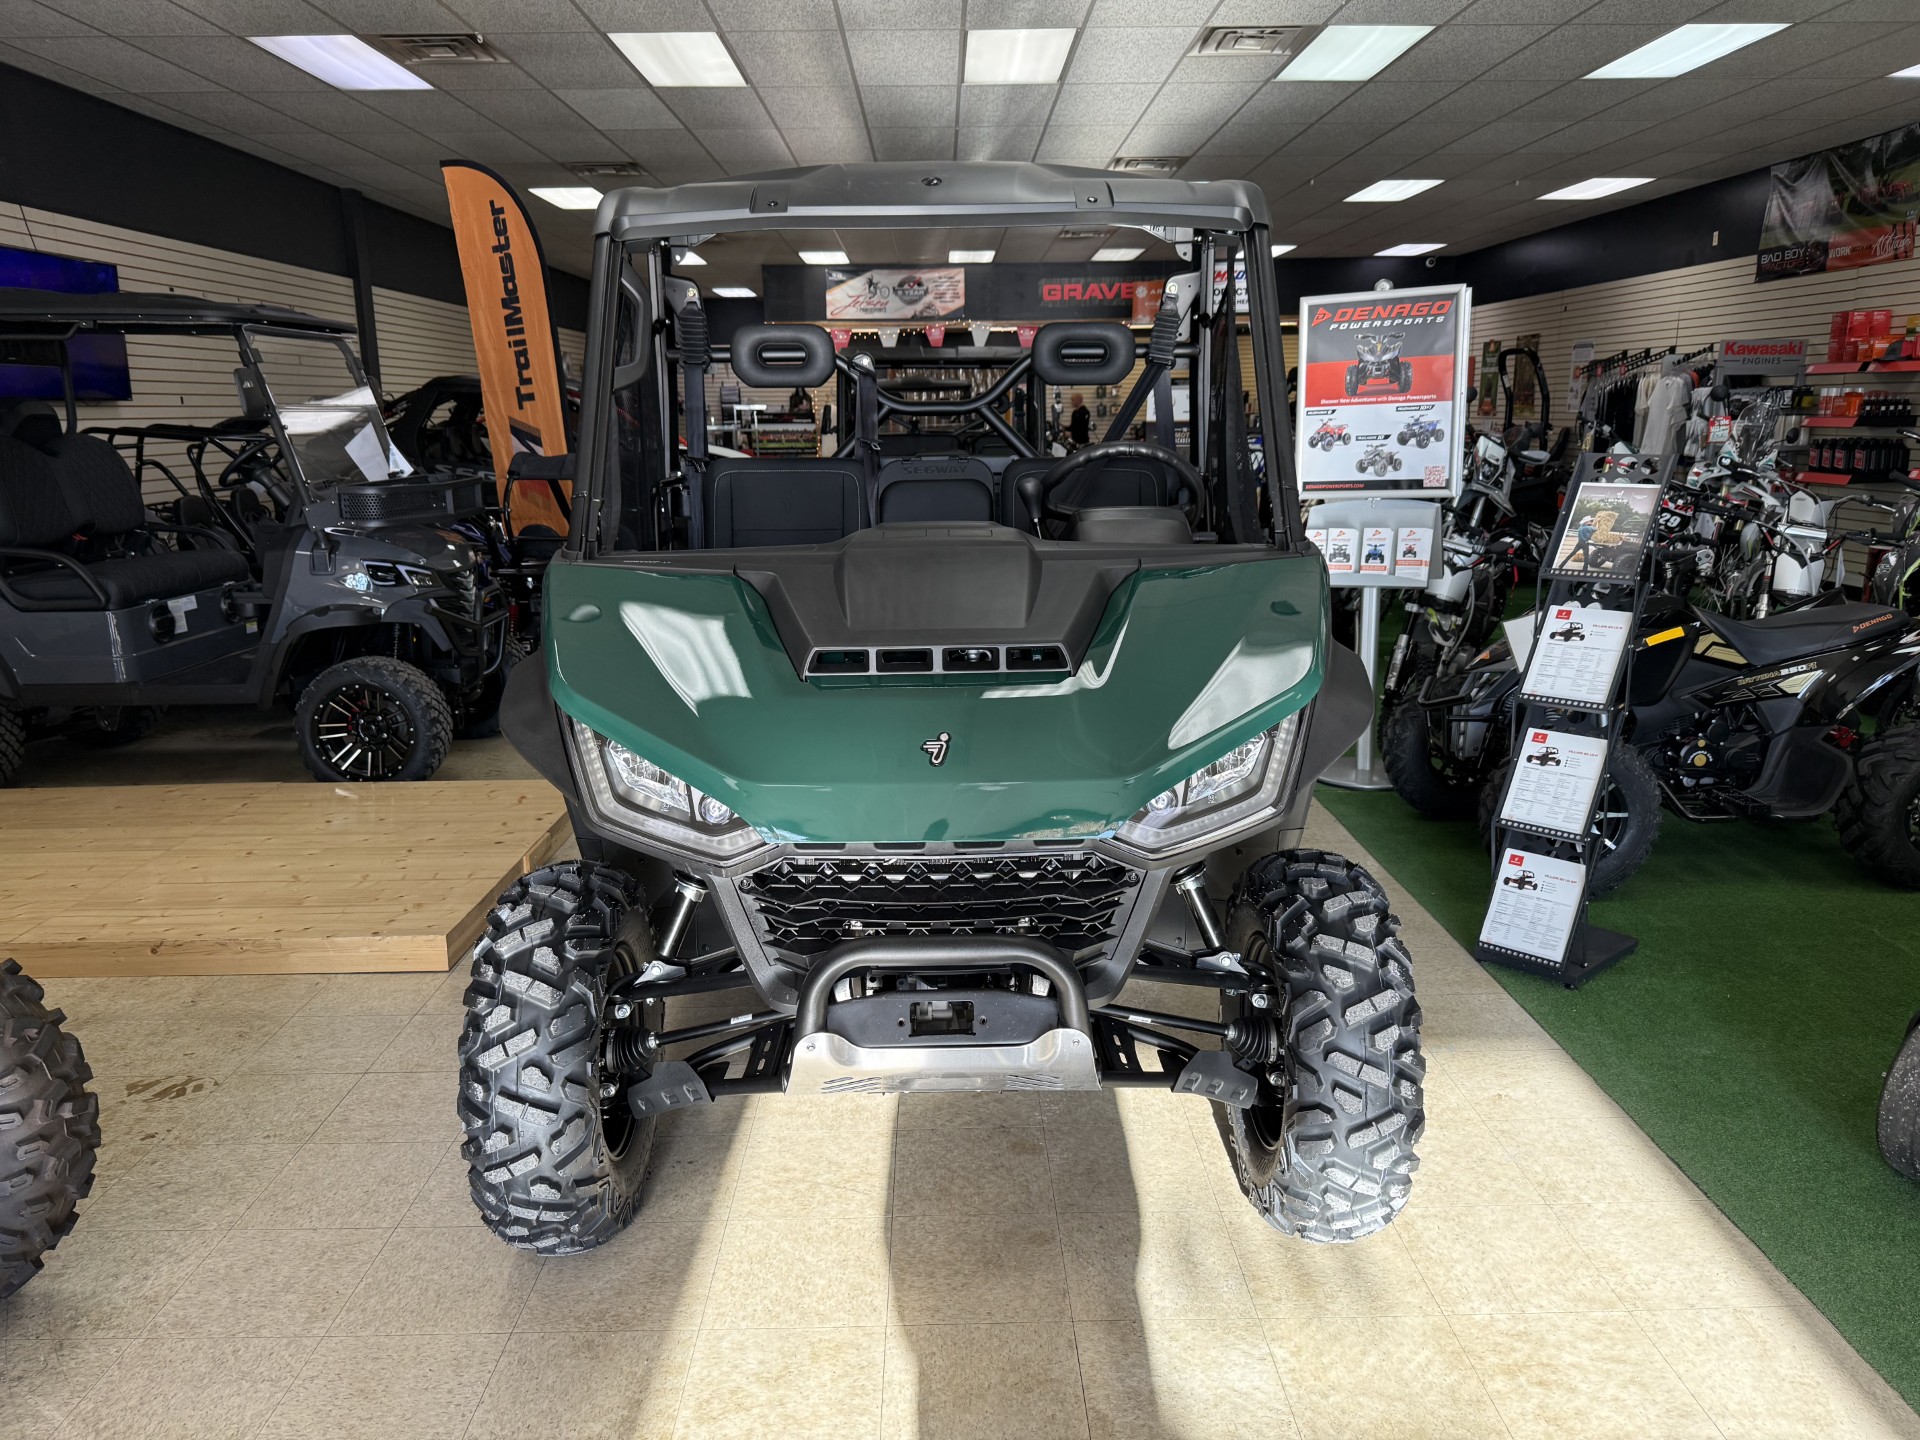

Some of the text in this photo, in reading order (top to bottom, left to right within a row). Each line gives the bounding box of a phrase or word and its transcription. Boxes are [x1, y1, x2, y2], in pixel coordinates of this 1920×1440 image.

[1761, 247, 1806, 264] BAD BOY
[1829, 245, 1850, 259] WORK
[489, 200, 536, 410] TrailMaster
[1333, 300, 1453, 323] DENAGO
[1329, 316, 1445, 331] POWERSPORTS
[1724, 341, 1804, 356] Kawasaki
[1742, 357, 1782, 365] ENGINES
[903, 465, 967, 475] SEGWAY
[1659, 512, 1681, 528] 29
[1858, 613, 1893, 630] DENAGO
